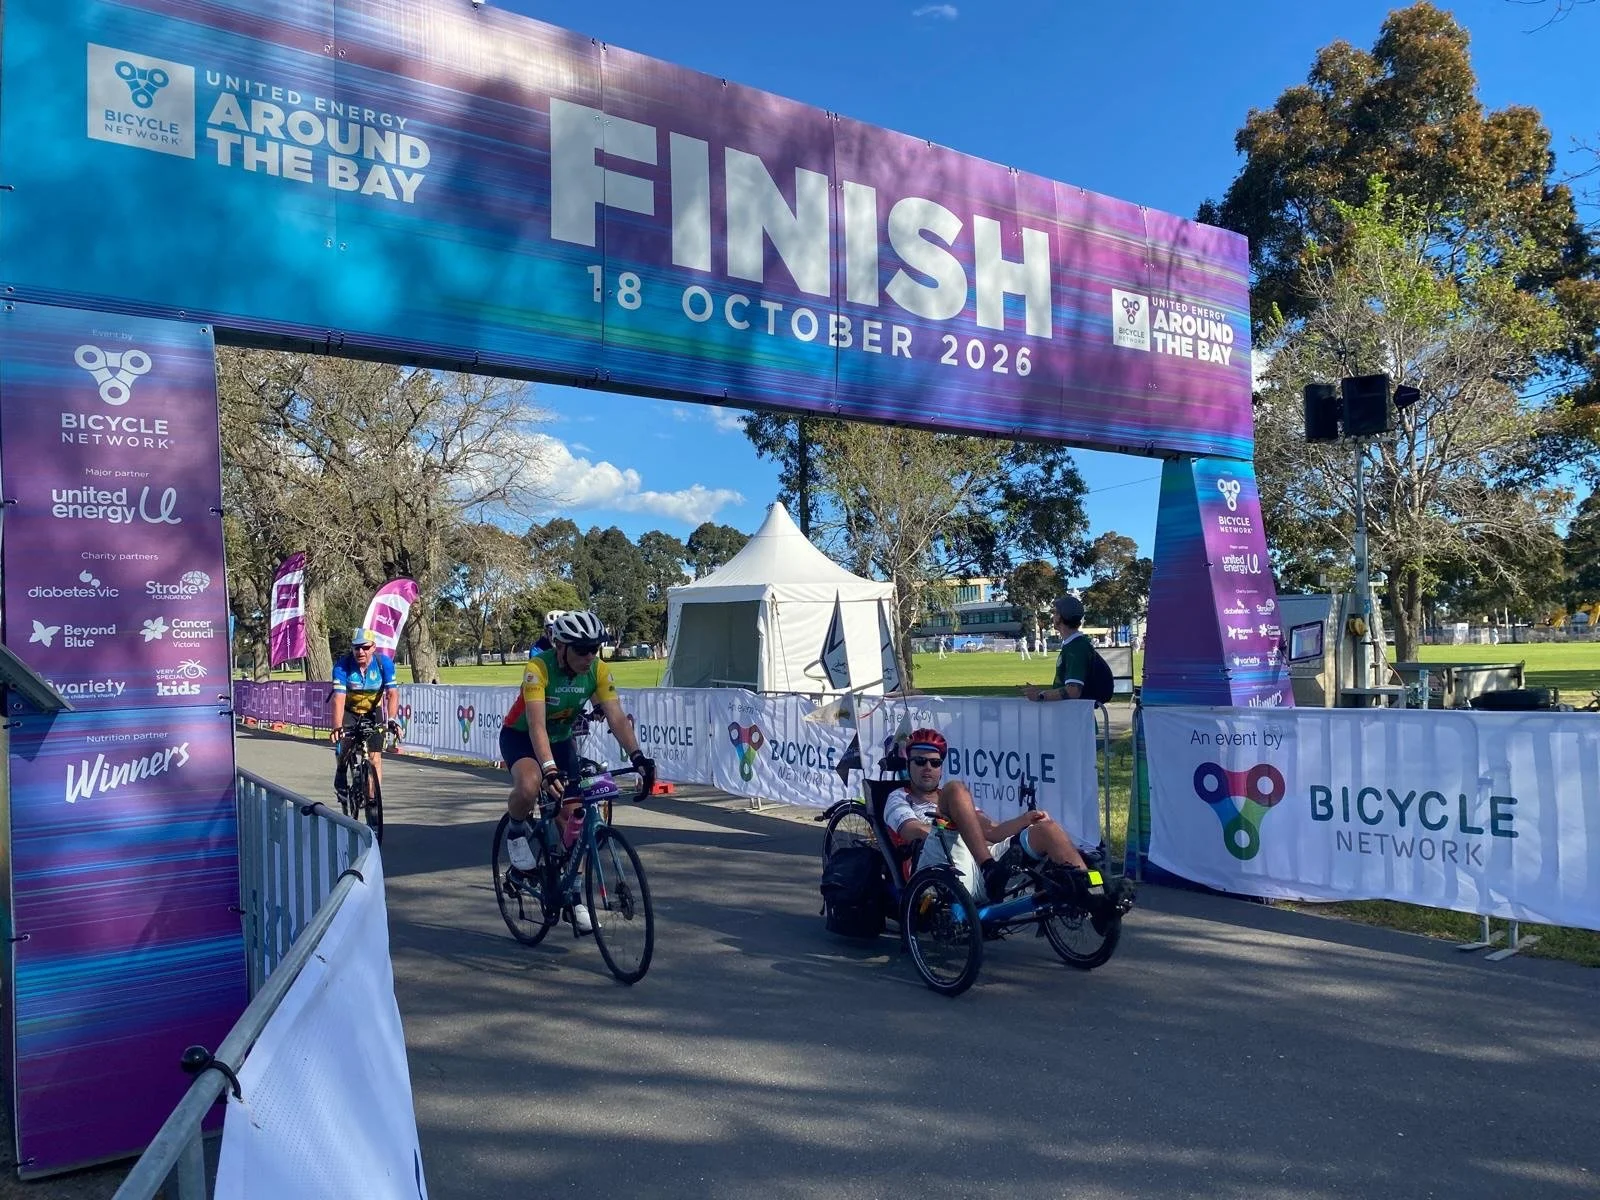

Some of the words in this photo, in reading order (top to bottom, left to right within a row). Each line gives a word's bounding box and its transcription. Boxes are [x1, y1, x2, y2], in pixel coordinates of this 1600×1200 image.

[206, 70, 302, 106] UNITED
[314, 97, 409, 130] ENERGY
[105, 109, 179, 134] BICYCLE
[207, 92, 431, 169] AROUND
[104, 123, 180, 145] NETWORK
[207, 128, 313, 184] THE
[328, 155, 426, 204] BAY
[550, 97, 1053, 339] FINISH
[1152, 296, 1188, 312] UNITED
[1191, 306, 1226, 322] ENERGY
[587, 265, 642, 311] 18
[682, 285, 913, 359] OCTOBER
[941, 334, 1033, 377] 2026
[1153, 309, 1234, 345] AROUND
[1118, 327, 1145, 339] BICYCLE
[1153, 331, 1194, 359] THE
[1198, 340, 1233, 366] BAY
[61, 413, 169, 435] BICYCLE
[61, 432, 169, 449] NETWORK
[86, 468, 113, 478] Major
[115, 470, 150, 478] partner
[52, 486, 127, 505] united
[52, 503, 136, 524] energy
[1218, 516, 1251, 527] BICYCLE
[81, 551, 116, 561] Charity
[119, 552, 159, 561] partners
[1222, 554, 1245, 565] united
[1223, 564, 1248, 574] energy
[146, 580, 198, 595] Stroke
[64, 624, 116, 638] Beyond
[172, 618, 212, 629] Cancer
[172, 628, 214, 639] Council
[64, 637, 95, 648] Blue
[56, 679, 126, 696] variety
[157, 682, 201, 696] kids
[413, 711, 439, 725] BICYCLE
[478, 713, 502, 729] BICYC
[87, 733, 131, 743] Nutrition
[133, 731, 169, 741] partner
[640, 724, 694, 746] BICYCLE
[1190, 730, 1210, 746] An
[1215, 730, 1258, 747] event
[1263, 730, 1283, 751] by
[770, 739, 836, 770] BICYCLE
[65, 742, 190, 804] Winners
[948, 747, 1056, 784] BICYCLE
[1310, 785, 1519, 838] BICYCLE
[1336, 830, 1483, 867] NETWORK
